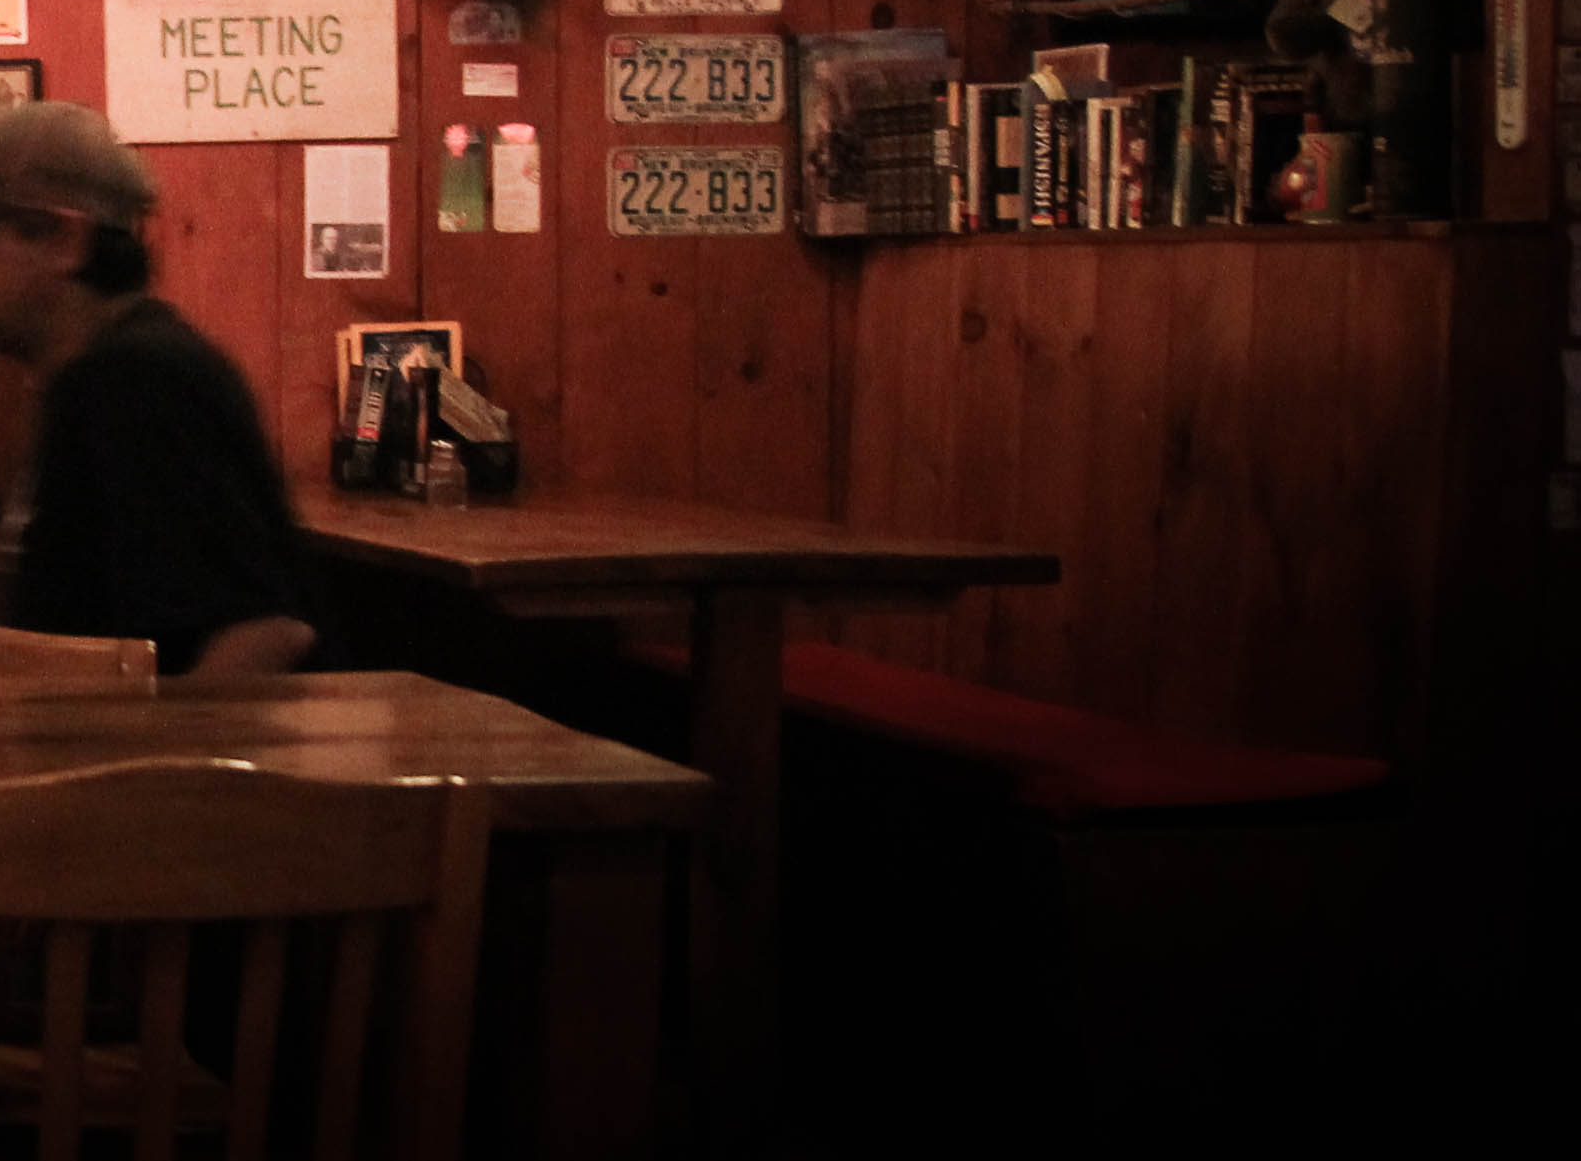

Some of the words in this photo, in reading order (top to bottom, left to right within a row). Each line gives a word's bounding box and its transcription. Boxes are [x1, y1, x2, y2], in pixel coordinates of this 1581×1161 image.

[159, 13, 343, 60] MEETING
[184, 65, 326, 110] PLACE
[620, 58, 688, 102] 222
[707, 58, 775, 102] 833
[620, 171, 689, 215] 222
[707, 170, 776, 214] 833
